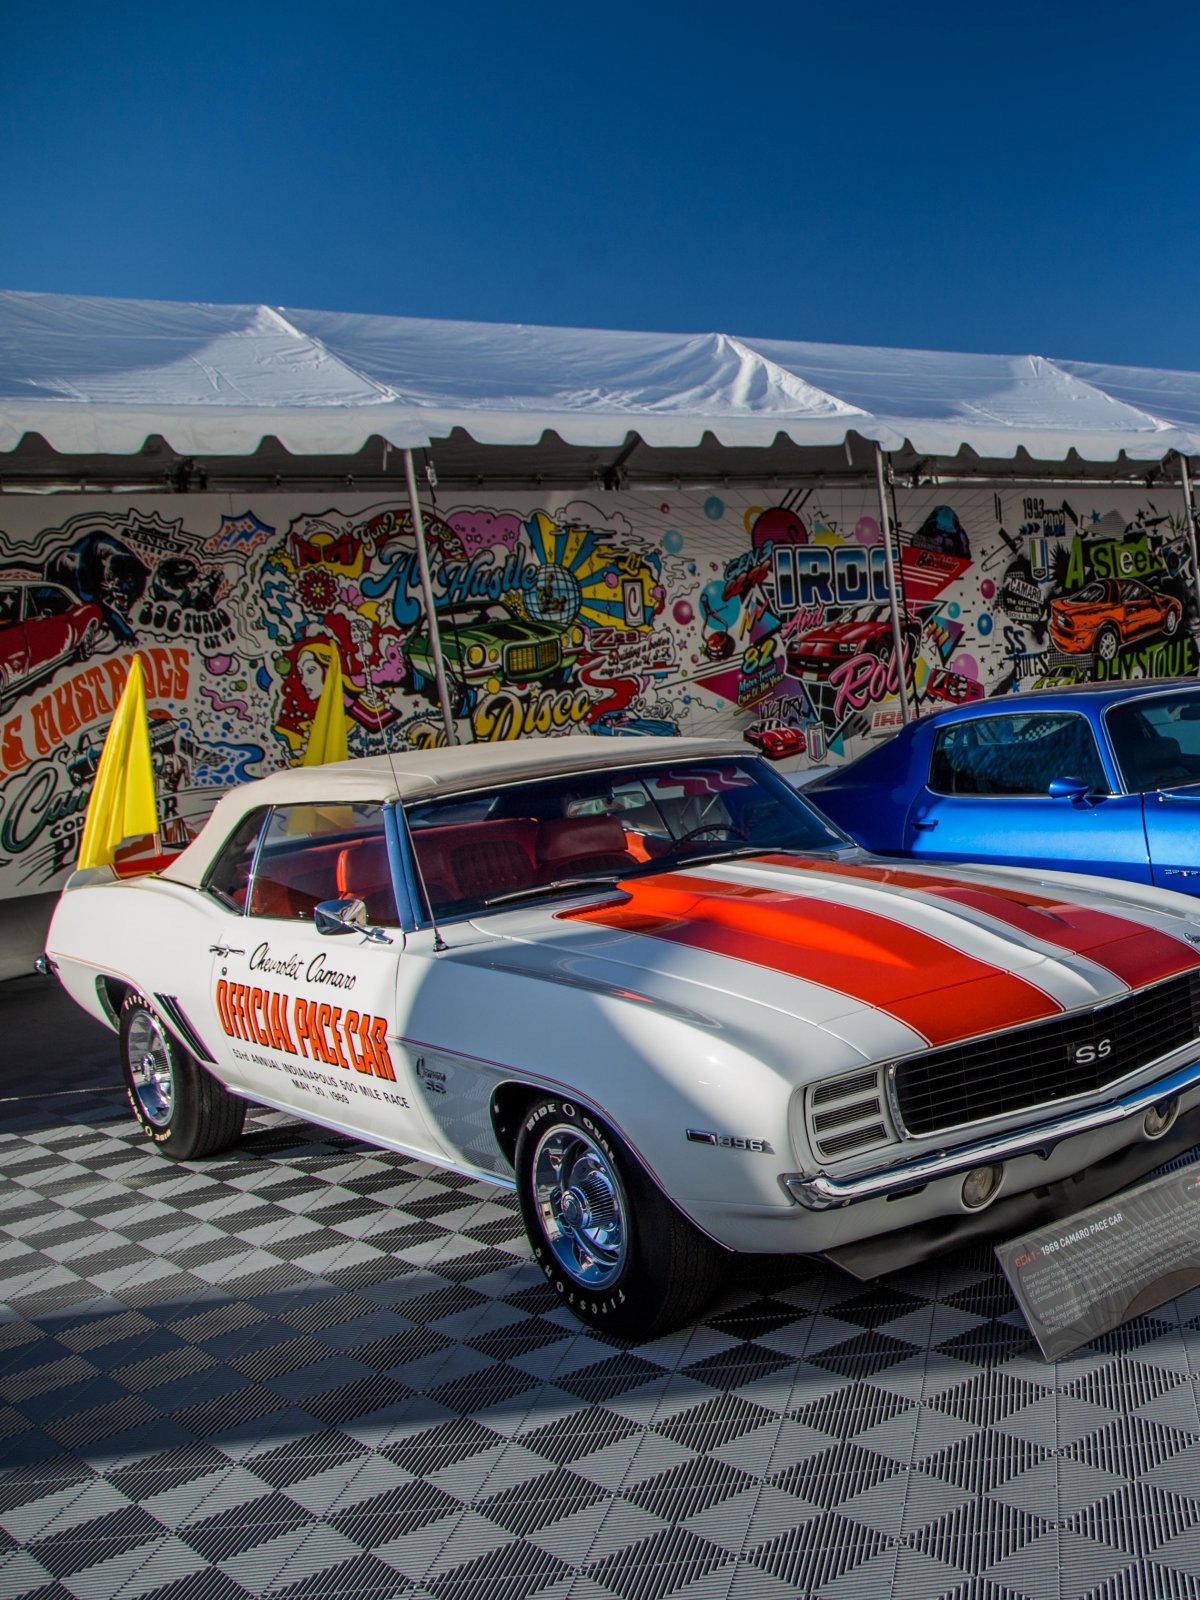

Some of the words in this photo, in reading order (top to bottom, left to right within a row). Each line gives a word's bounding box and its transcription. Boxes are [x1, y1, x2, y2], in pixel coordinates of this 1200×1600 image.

[1023, 498, 1044, 519] 1993
[126, 529, 179, 552] YENKO
[438, 541, 538, 603] Hustle
[724, 547, 762, 583] GEN
[761, 538, 775, 565] 3
[775, 544, 904, 612] IROC
[1064, 535, 1084, 590] A
[1091, 543, 1164, 578] Sleek
[1009, 578, 1042, 602] CAMARO
[138, 602, 182, 632] 396
[184, 608, 230, 635] TURBO
[592, 628, 640, 649] Z28
[743, 636, 782, 675] 82
[1004, 626, 1026, 655] SS
[829, 646, 914, 722] Roll
[1015, 654, 1049, 681] RULES
[31, 649, 189, 755] MUSTANGS
[473, 688, 593, 743] Disco
[250, 942, 305, 980] Chevrolet
[306, 953, 357, 991] Camaro
[216, 979, 299, 1056] OFFICIAL
[293, 997, 350, 1070] PACE
[343, 1010, 398, 1082] CAR
[1076, 1039, 1111, 1063] SS
[232, 1048, 250, 1063] 53rd
[251, 1053, 282, 1073] ANNUAL
[283, 1062, 337, 1089] INDIANAPOLIS
[339, 1080, 358, 1094] 500
[359, 1085, 382, 1101] MILE
[383, 1092, 411, 1109] RACE
[292, 1079, 312, 1095] MAY
[332, 1090, 350, 1105] 1969
[526, 1103, 558, 1132] WIDE
[718, 1135, 764, 1152] 396
[1014, 1253, 1031, 1266] GEN
[1039, 1240, 1060, 1255] 1969
[1058, 1227, 1090, 1247] CAMARO
[1088, 1218, 1109, 1234] PACE
[1107, 1212, 1124, 1225] CAR
